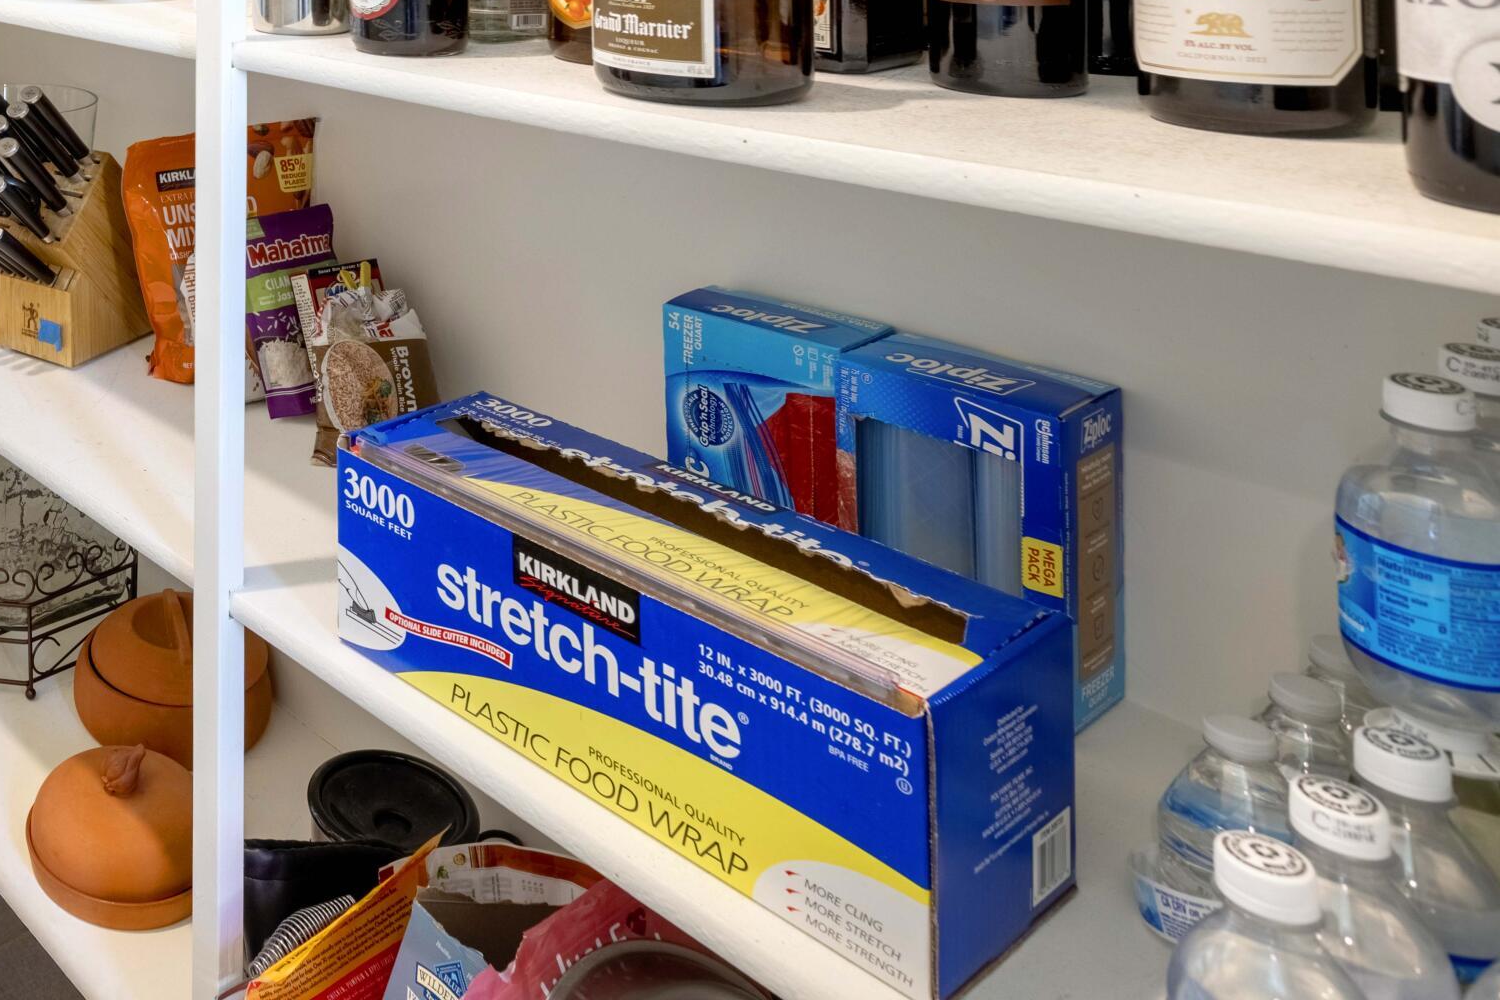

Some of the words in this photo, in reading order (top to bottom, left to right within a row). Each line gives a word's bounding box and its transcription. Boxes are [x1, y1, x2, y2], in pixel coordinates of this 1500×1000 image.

[622, 13, 692, 39] Marnier
[159, 170, 195, 185] KIRKL
[280, 158, 306, 173] 85%
[247, 234, 331, 269] Mahatma
[668, 311, 681, 331] 54
[683, 314, 694, 365] FREEZER
[694, 315, 703, 350] QUART
[711, 304, 826, 334] Ziploc
[395, 346, 418, 413] Brown
[886, 350, 1013, 391] Ziploc
[708, 394, 717, 443] Technology
[343, 467, 416, 529] 3000
[656, 463, 777, 513] KIRKLAND
[345, 500, 385, 527] SQUARE
[388, 522, 413, 541] FEET
[510, 491, 613, 543] PLASTIC
[608, 533, 692, 576] FOOD
[694, 570, 795, 619] WRAP
[649, 535, 742, 580] PROFESSIONAL
[745, 578, 811, 611] QUALITY
[1027, 547, 1040, 583] PACK
[1043, 549, 1055, 588] MEGA
[1377, 556, 1434, 583] Nutrition
[518, 551, 636, 625] KIRKLAND
[389, 611, 422, 634] OPTIONAL
[422, 624, 442, 639] SLIDE
[442, 630, 469, 646] CUTTER
[469, 636, 507, 662] INCLUDED
[436, 562, 742, 760] stretch-tite
[698, 643, 714, 661] 12
[716, 652, 735, 672] IN.
[738, 665, 747, 676] x
[749, 667, 783, 695] 3000
[786, 686, 807, 707] FT.
[809, 697, 852, 728] (3000
[854, 718, 880, 742] SQ.
[884, 732, 912, 759] FT.)
[698, 660, 734, 688] 30.48
[736, 683, 756, 701] cm
[759, 694, 767, 706] x
[770, 697, 809, 727] 914.4
[811, 719, 826, 736] m
[829, 725, 876, 759] (278.7
[879, 750, 910, 778] m2)
[451, 682, 551, 763] PLASTIC
[554, 747, 639, 814] FOOD
[648, 799, 750, 876] WRAP
[710, 753, 734, 772] BRAND
[828, 744, 846, 761] BPA
[846, 753, 870, 774] FREE
[588, 745, 682, 811] PROFESSIONAL
[684, 803, 746, 847] QUALITY
[804, 878, 842, 908] MORE
[844, 902, 884, 934] CLING
[804, 896, 842, 926] MORE
[845, 919, 902, 962] STRETCH
[805, 914, 845, 945] MORE
[848, 938, 914, 988] STRENGTH
